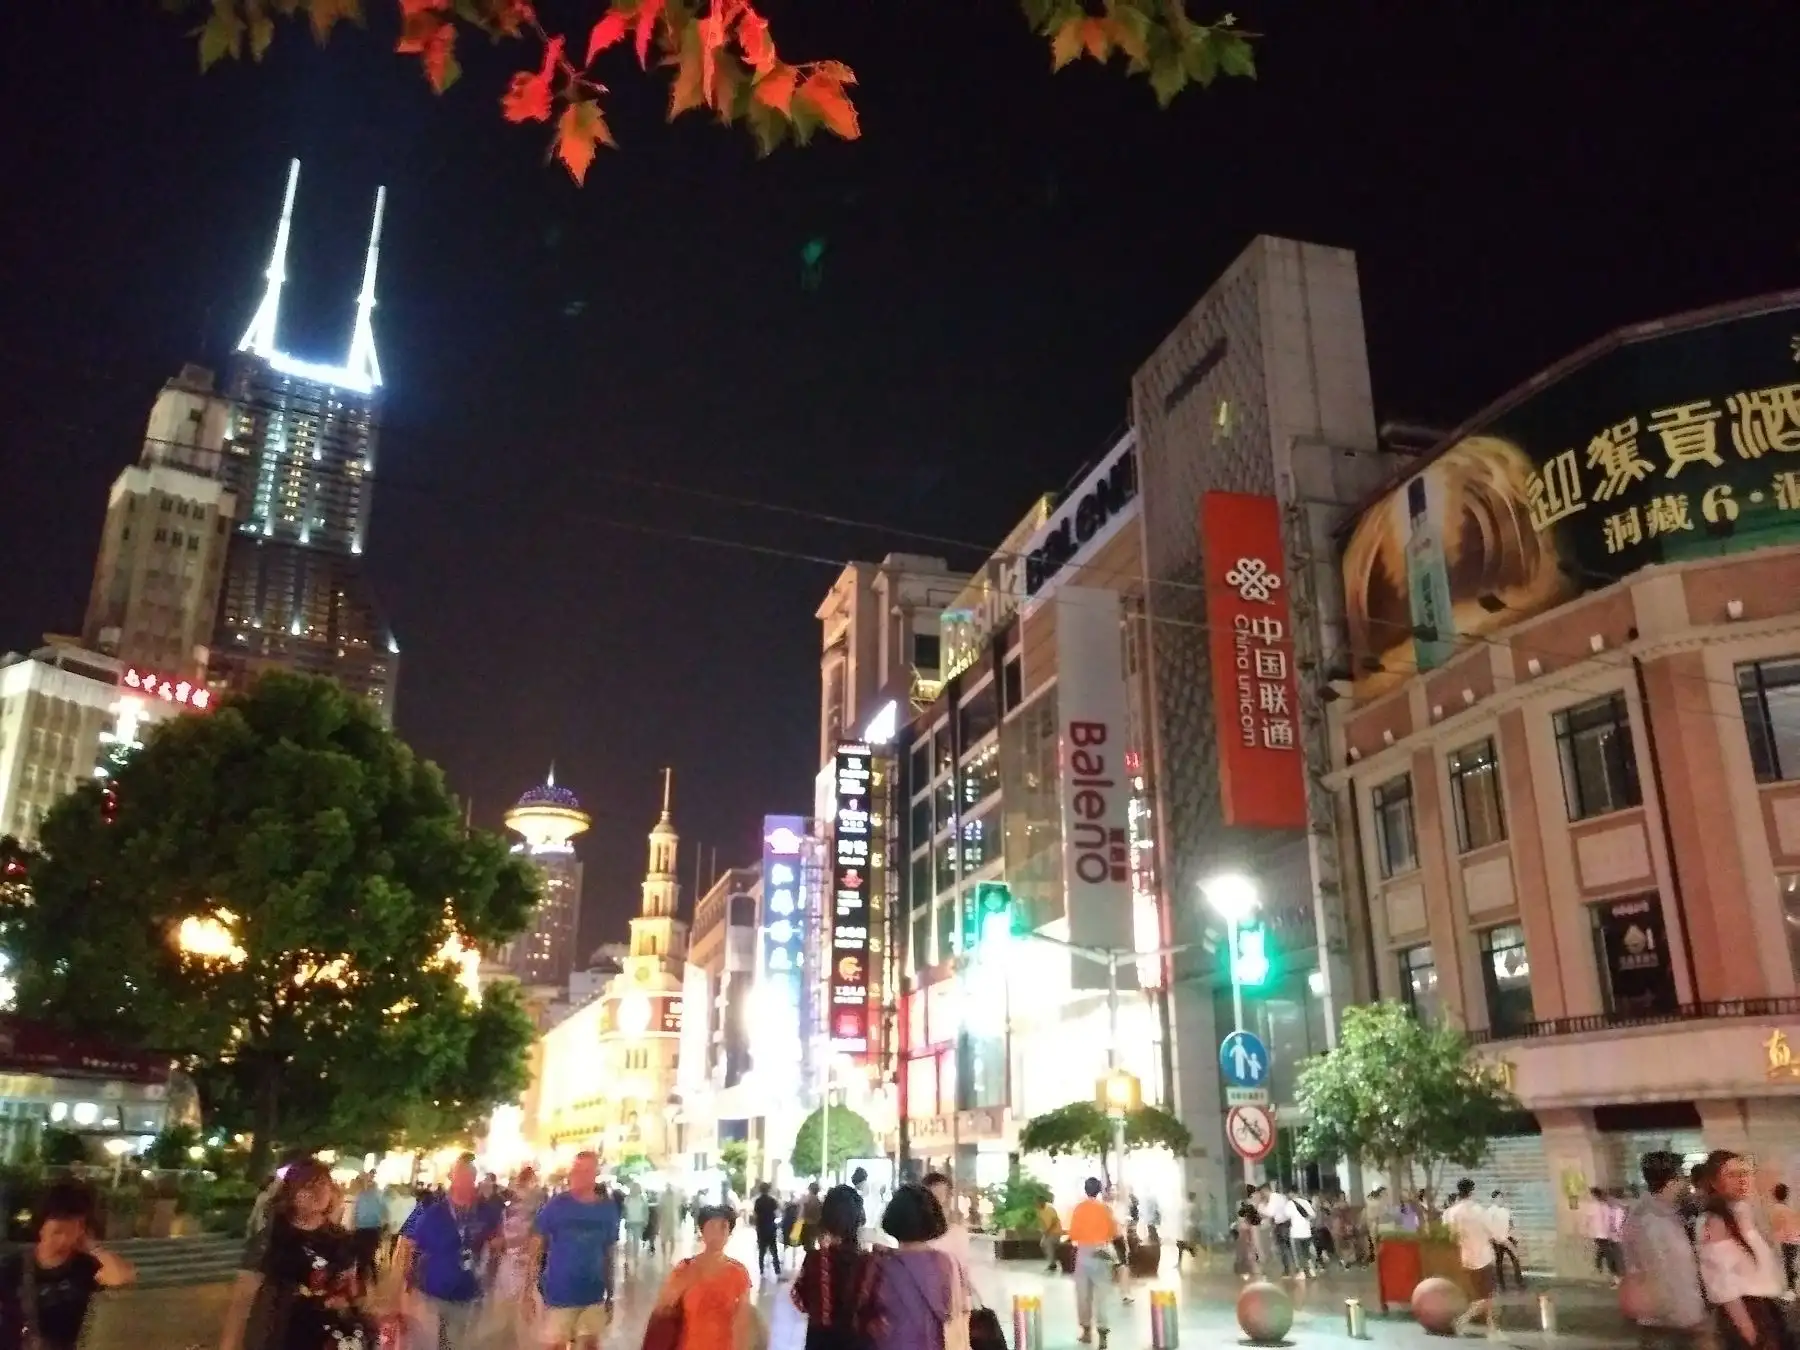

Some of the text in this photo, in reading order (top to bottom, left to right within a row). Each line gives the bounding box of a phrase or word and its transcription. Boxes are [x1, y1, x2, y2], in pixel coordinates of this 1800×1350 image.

[1237, 674, 1256, 747] unicom
[1253, 615, 1294, 750] 中国联通
[1069, 721, 1114, 884] Baleno
